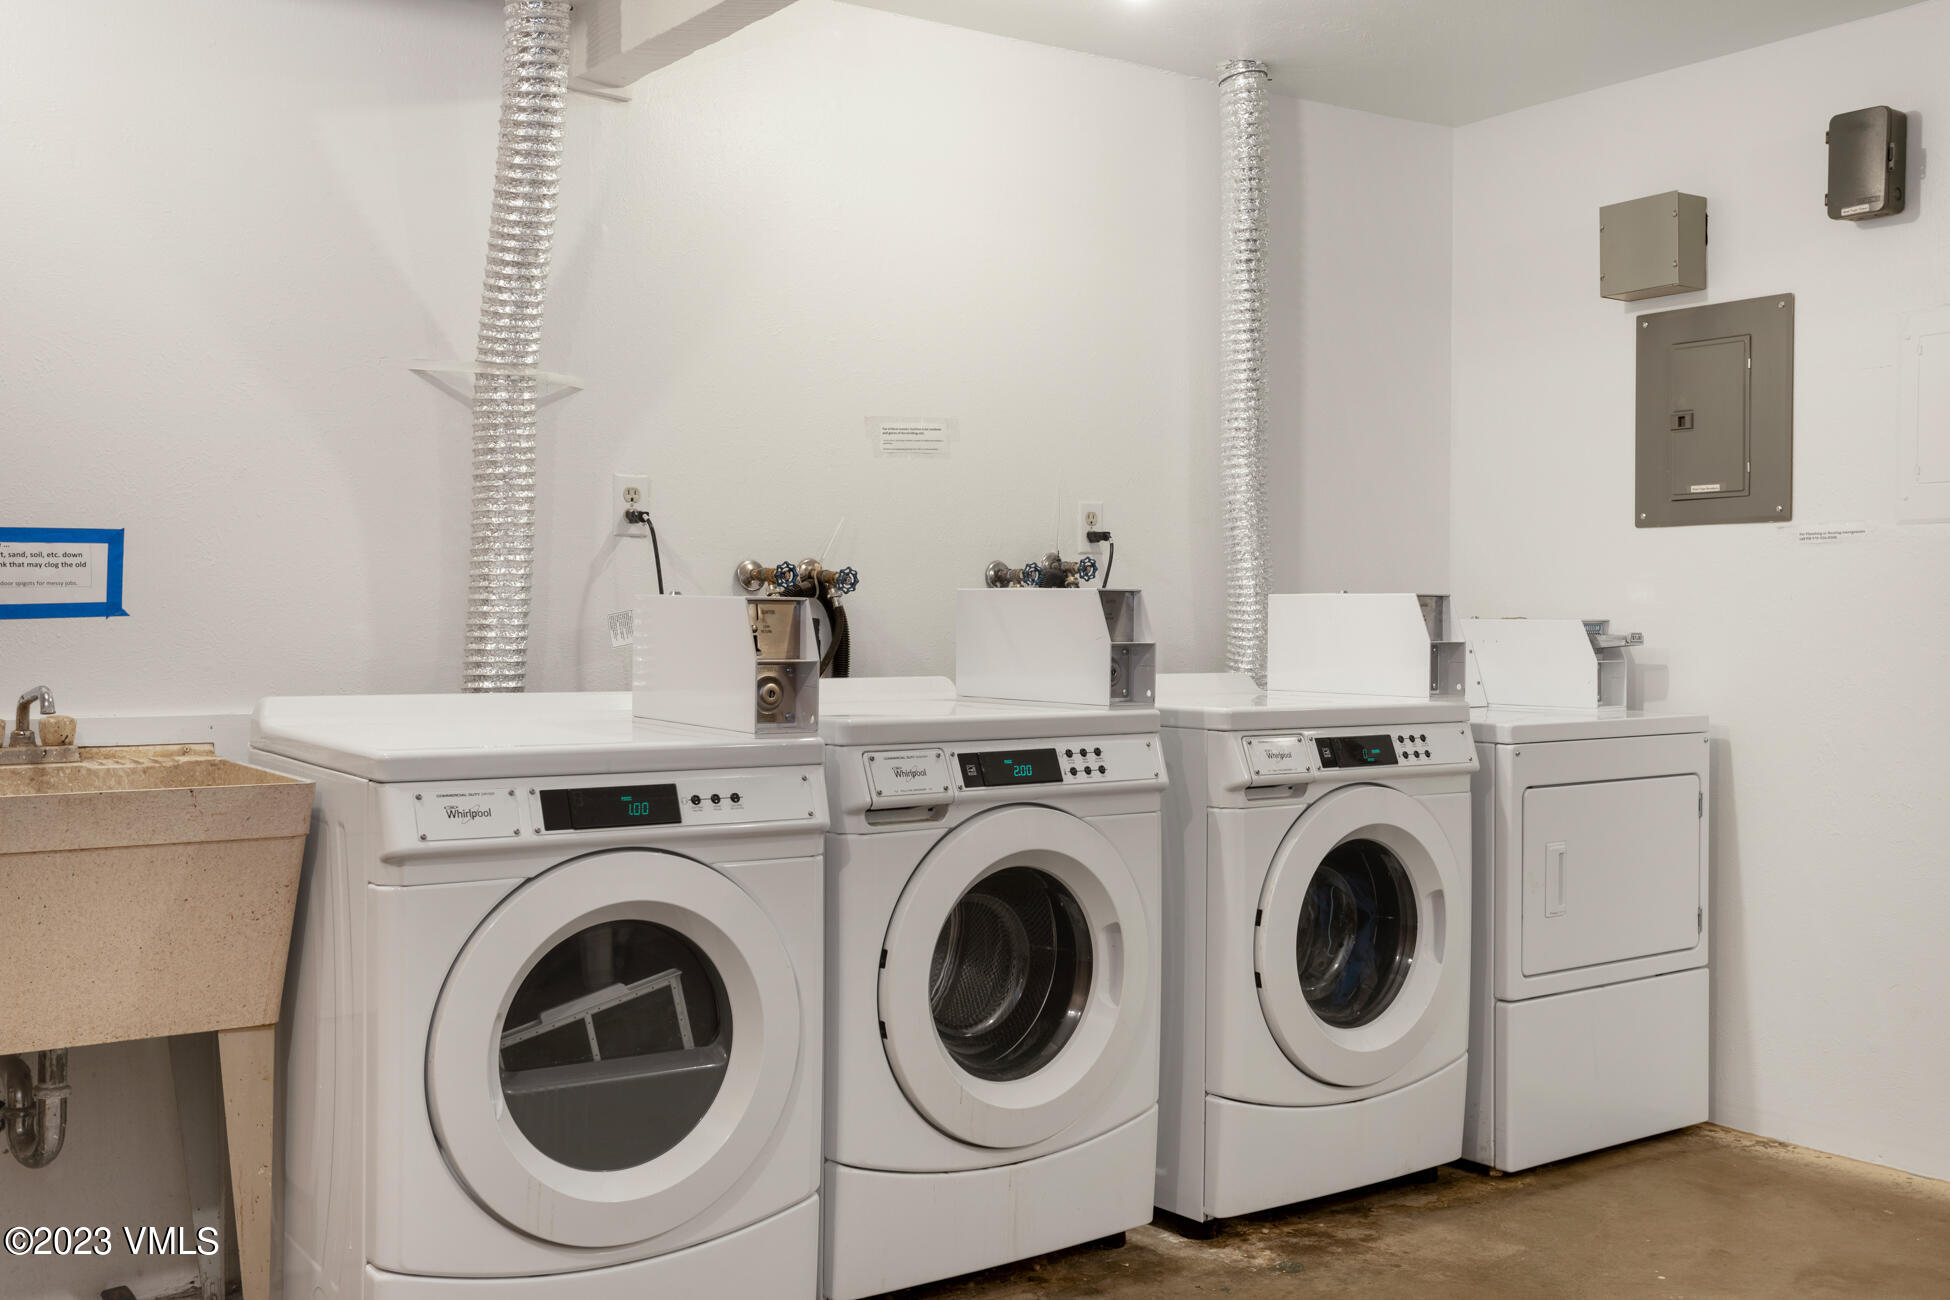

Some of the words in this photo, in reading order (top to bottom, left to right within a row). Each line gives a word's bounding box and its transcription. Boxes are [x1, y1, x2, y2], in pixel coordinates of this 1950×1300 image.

[9, 560, 25, 568] that
[44, 561, 60, 569] clog
[1265, 752, 1293, 761] Whirlpool
[894, 768, 928, 779] Whirlpool
[1013, 765, 1033, 776] 2.00
[446, 808, 492, 821] Whirlpool
